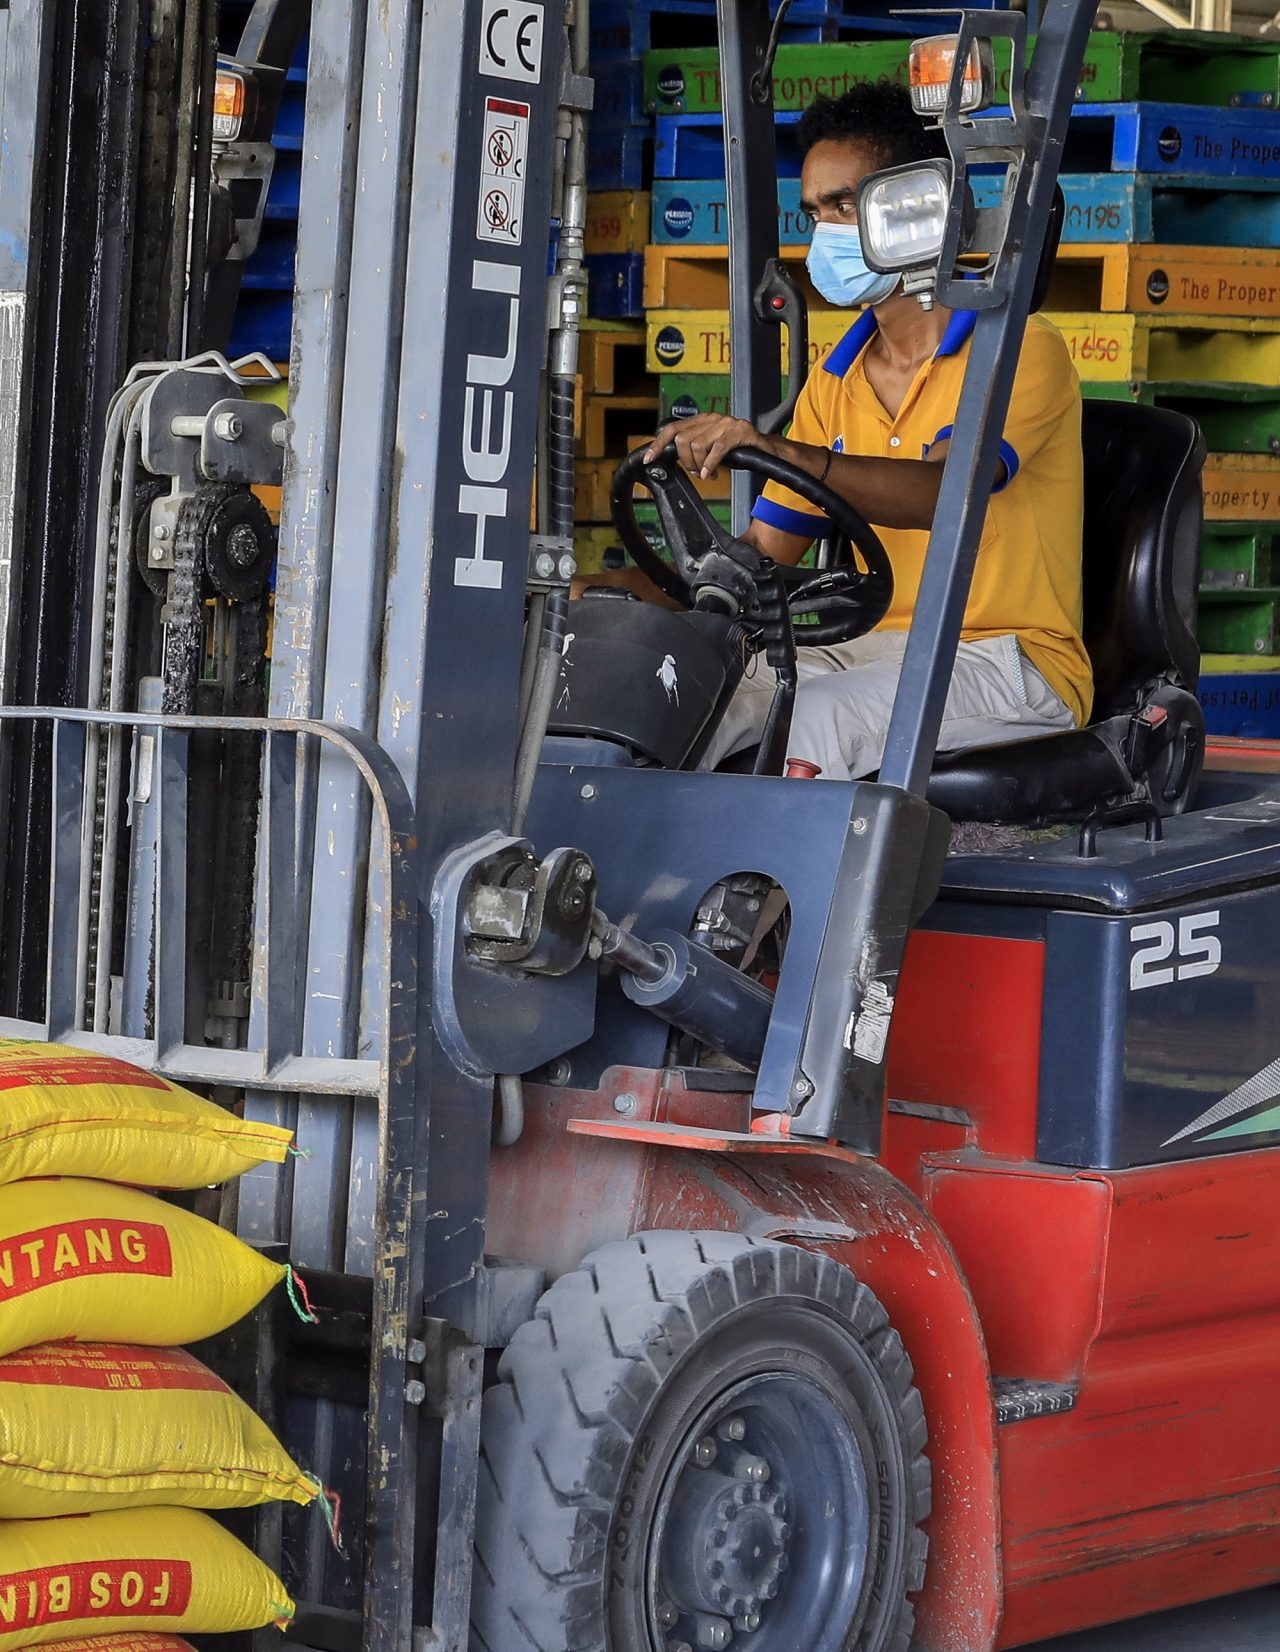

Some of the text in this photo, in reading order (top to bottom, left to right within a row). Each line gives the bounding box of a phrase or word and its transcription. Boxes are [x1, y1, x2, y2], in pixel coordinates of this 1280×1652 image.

[486, 9, 538, 73] CE
[1193, 135, 1222, 158] The
[1181, 276, 1210, 300] The
[1069, 333, 1119, 363] 1650
[454, 259, 522, 590] HELI
[1203, 488, 1270, 511] roperty
[1130, 910, 1222, 991] 25
[105, 1373, 126, 1388] LOT:
[870, 1459, 893, 1602] solideal
[89, 1570, 171, 1612] FOS
